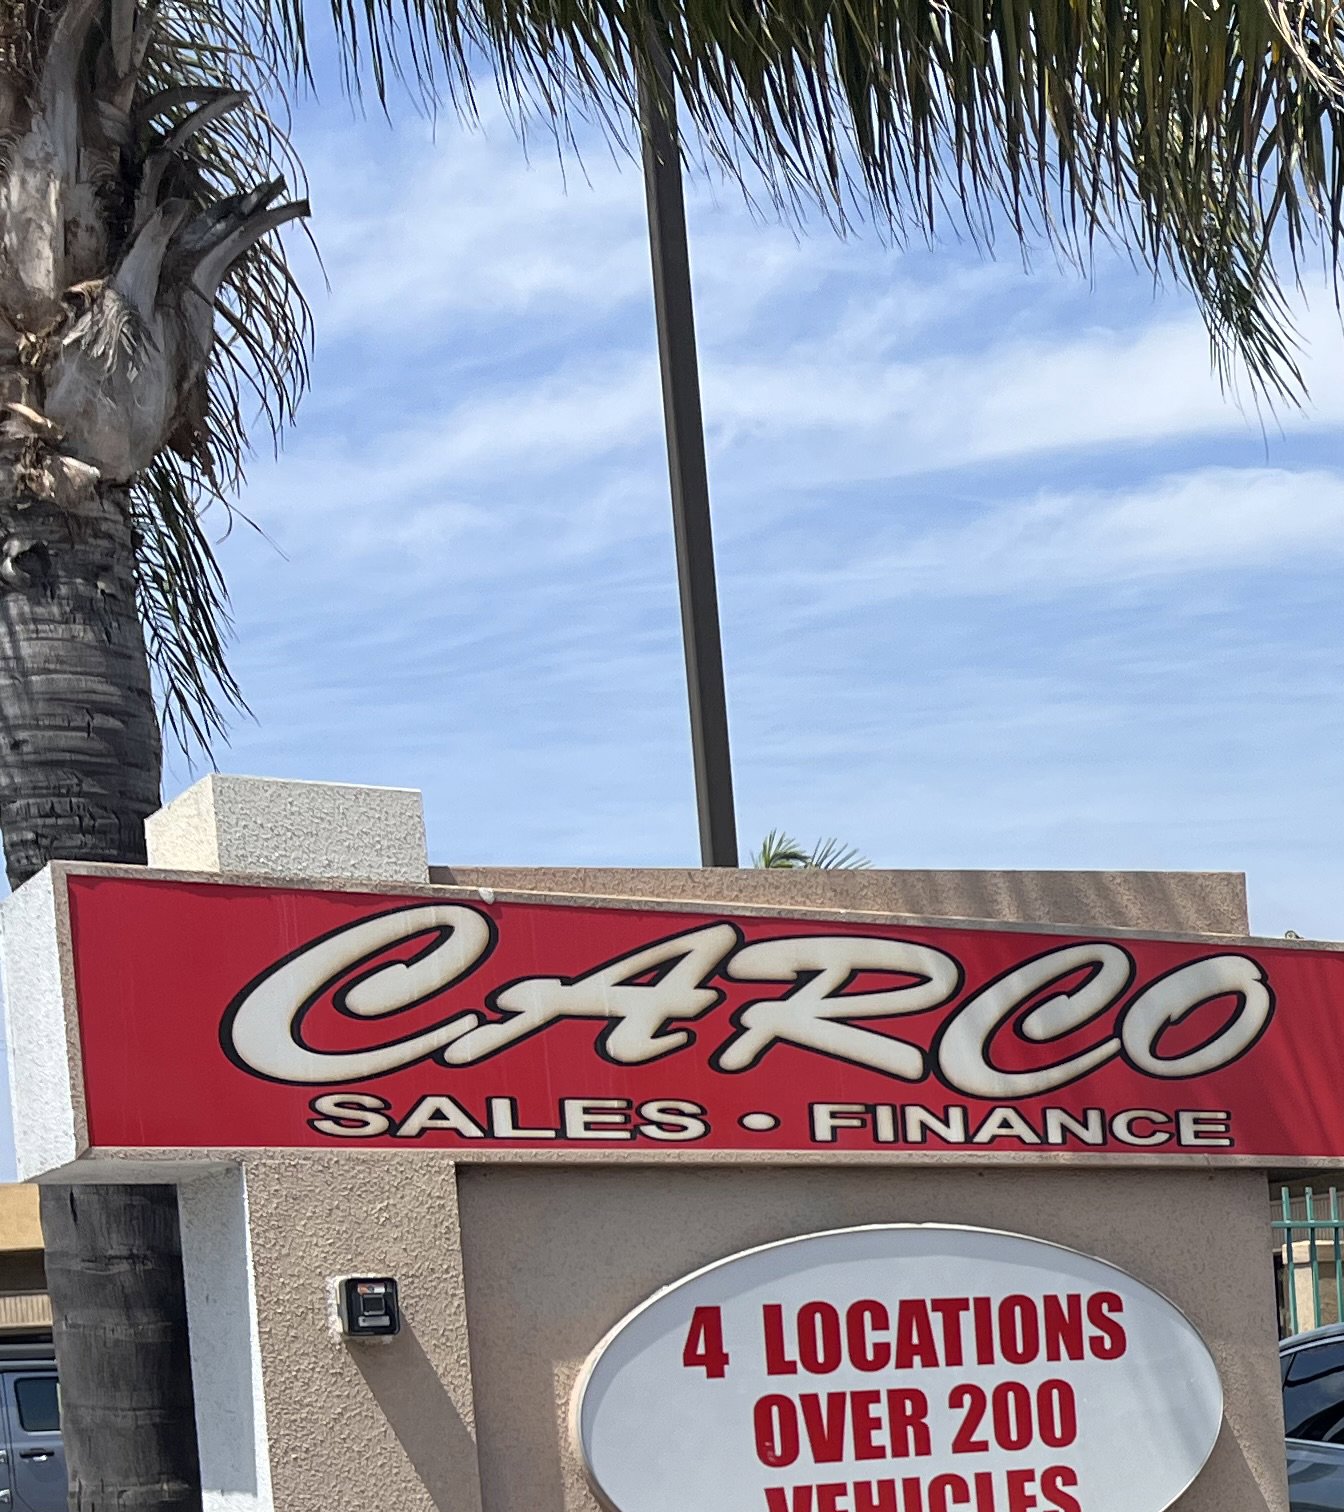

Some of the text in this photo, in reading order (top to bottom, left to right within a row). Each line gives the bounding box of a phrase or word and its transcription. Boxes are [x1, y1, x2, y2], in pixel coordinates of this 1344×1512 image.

[219, 903, 1275, 1099] CARCO
[306, 1092, 1237, 1148] SALES FINANCE
[682, 1291, 1127, 1379] 4 LOCATIONS
[753, 1379, 1077, 1468] OVER 200
